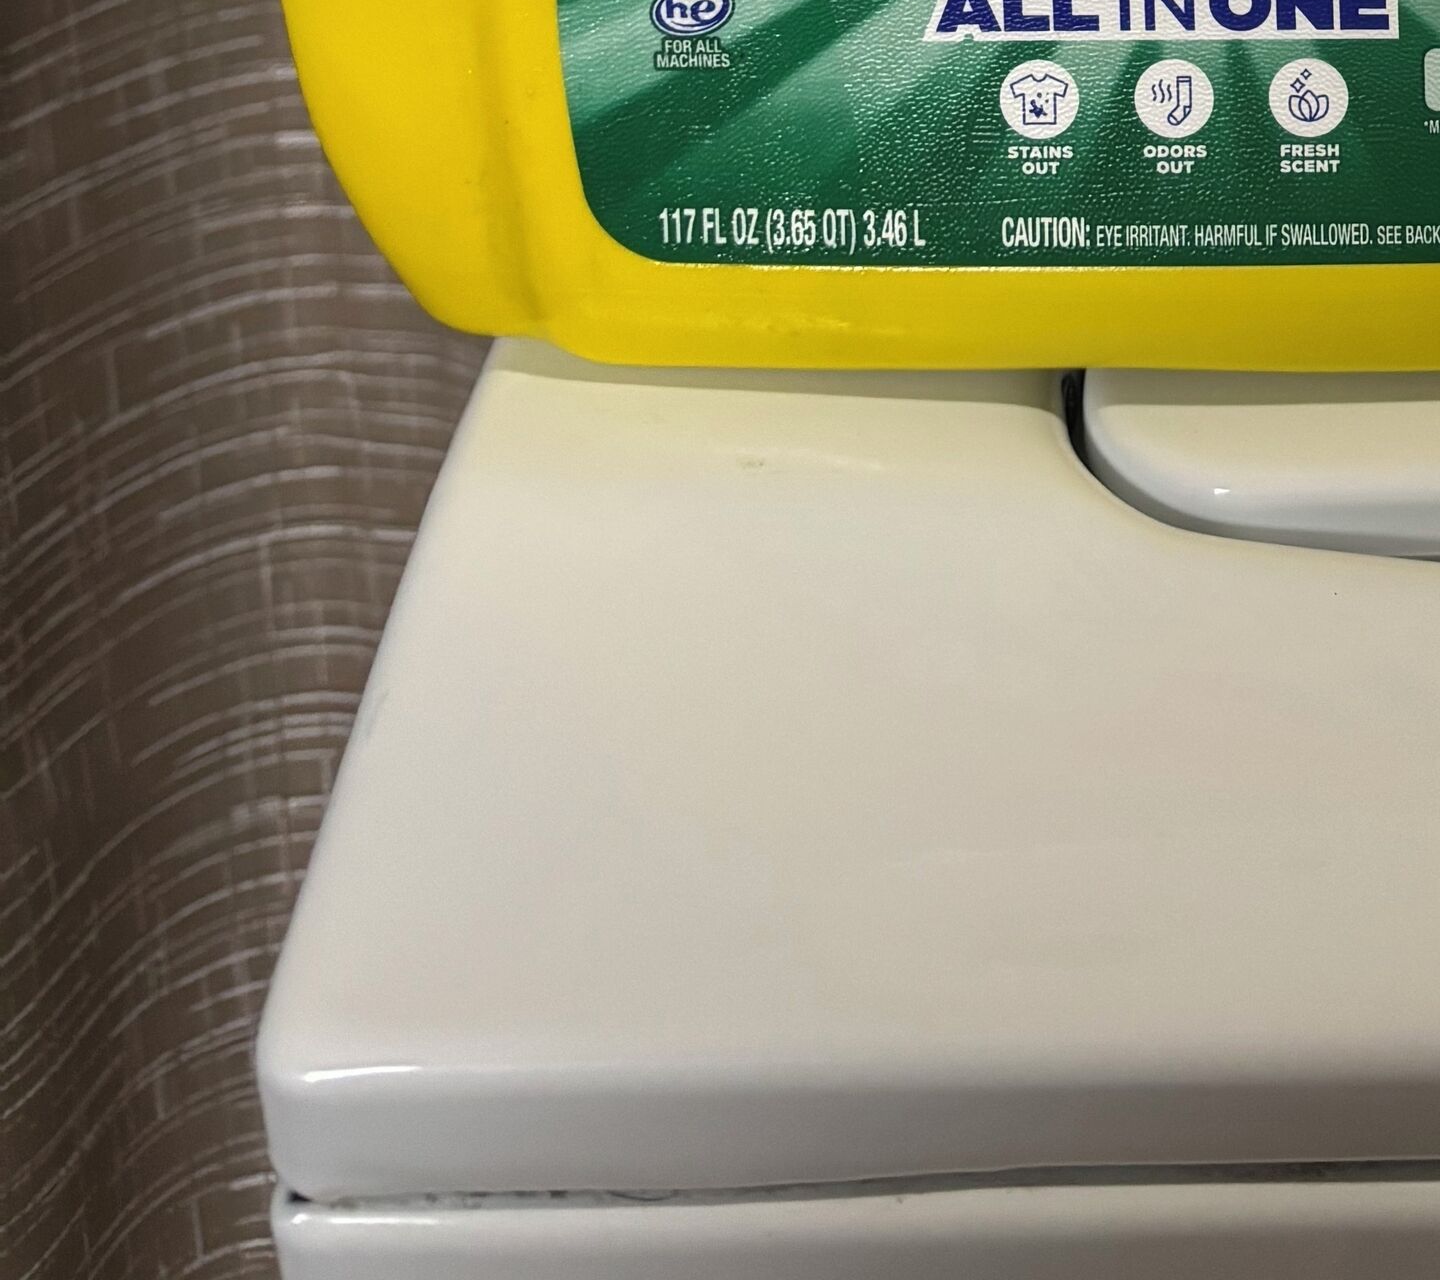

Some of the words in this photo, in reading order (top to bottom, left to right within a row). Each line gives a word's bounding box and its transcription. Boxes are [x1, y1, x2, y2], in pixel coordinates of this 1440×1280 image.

[664, 39, 692, 54] FOR
[695, 39, 723, 54] ALL
[656, 53, 731, 68] MACHINES
[1007, 144, 1074, 160] STAINS
[1142, 144, 1208, 159] ODORS
[1279, 143, 1341, 158] FRESH
[1021, 160, 1061, 176] OUT
[1155, 160, 1196, 175] OUT
[1279, 158, 1341, 174] SCENT
[659, 207, 698, 246] 117
[702, 208, 728, 247] FL
[731, 207, 760, 247] OZ
[766, 207, 817, 253] (3.65
[821, 208, 857, 254] QT)
[862, 208, 909, 247] 3.46
[912, 208, 927, 248] L
[1001, 216, 1092, 249] CAUTION:
[1096, 224, 1124, 248] EYE
[1125, 224, 1192, 248] IRRITANT.
[1193, 224, 1263, 248] HARMFUL
[1264, 224, 1279, 247] IF
[1281, 222, 1375, 247] SWALLOWED.
[1376, 225, 1403, 246] SEE
